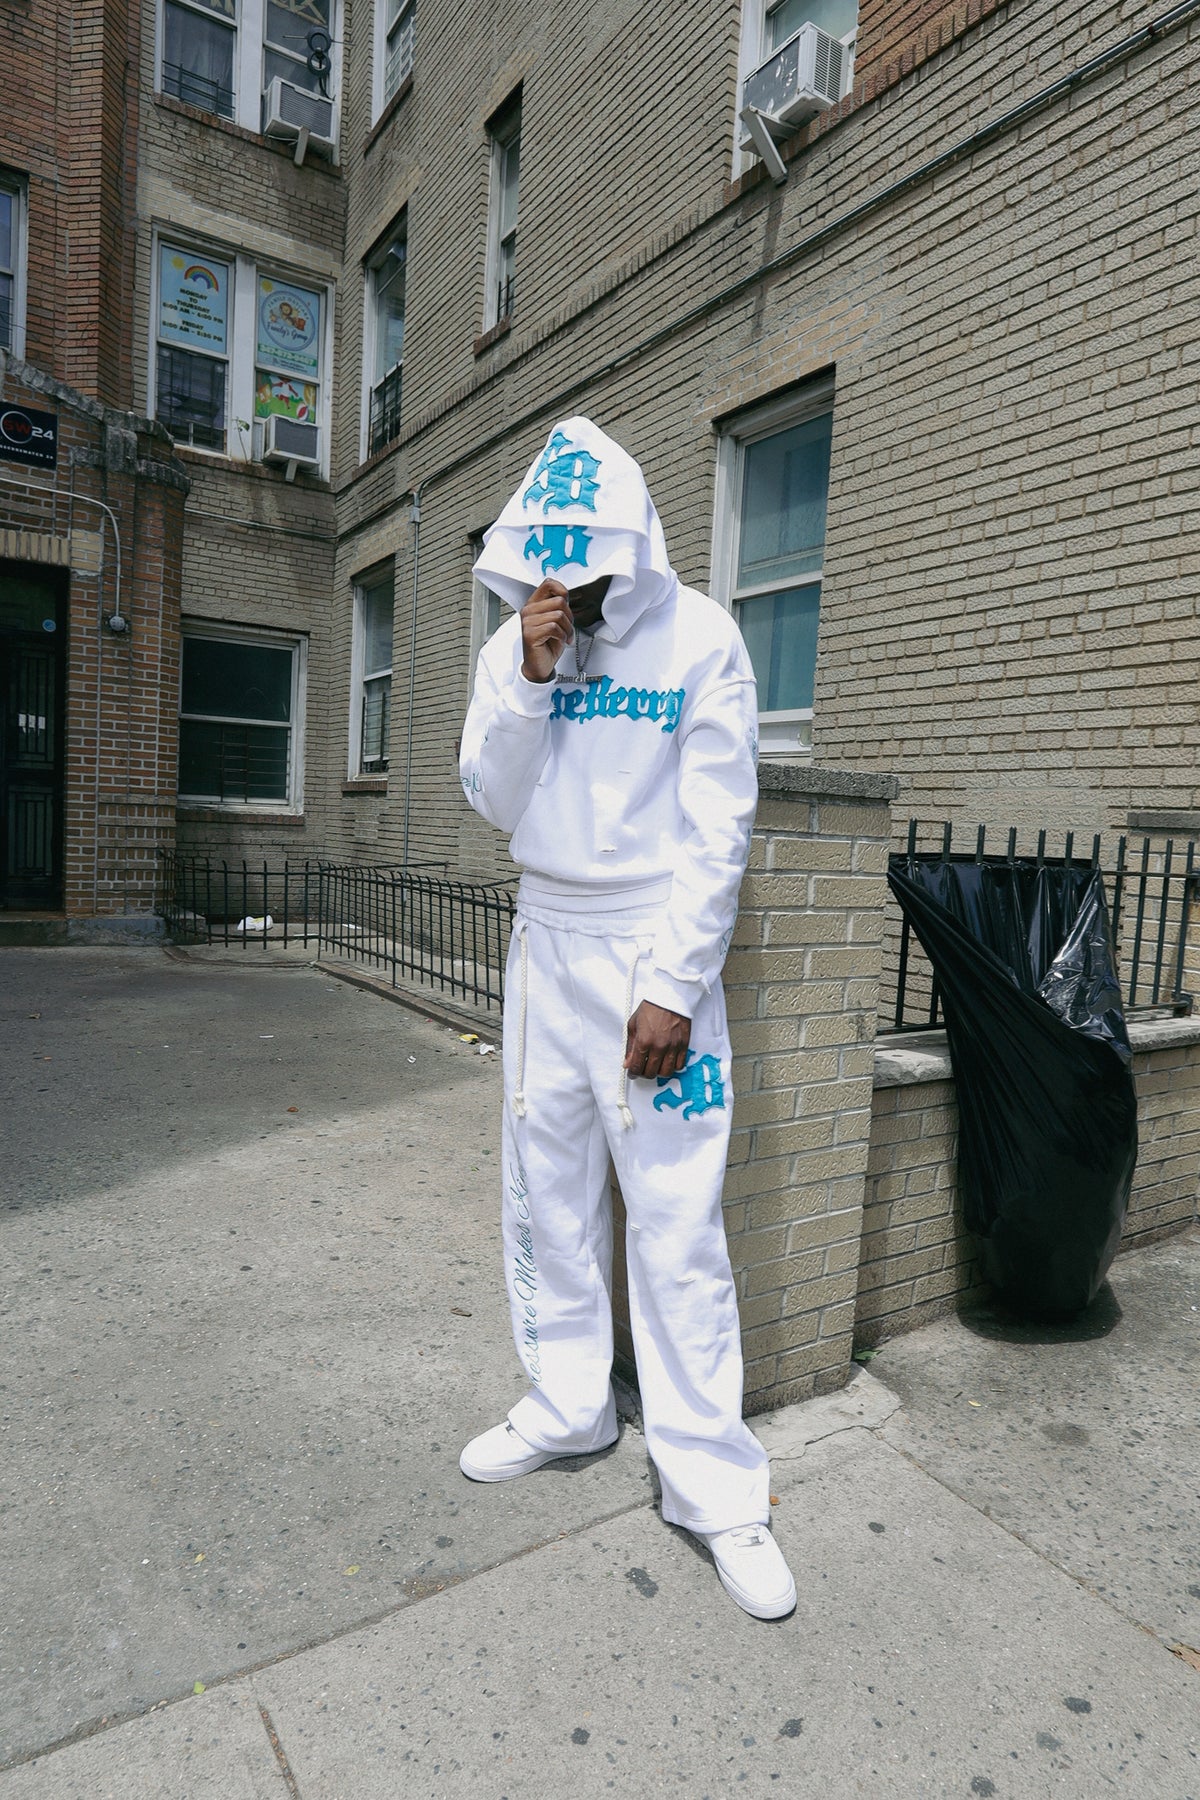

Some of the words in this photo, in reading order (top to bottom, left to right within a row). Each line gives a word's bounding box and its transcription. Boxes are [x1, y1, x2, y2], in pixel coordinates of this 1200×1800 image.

[180, 288, 208, 300] MONDAY
[176, 299, 210, 313] THURSDAY
[179, 325, 190, 333] AM
[182, 320, 204, 330] FRIDAY
[514, 1223, 538, 1301] Makes
